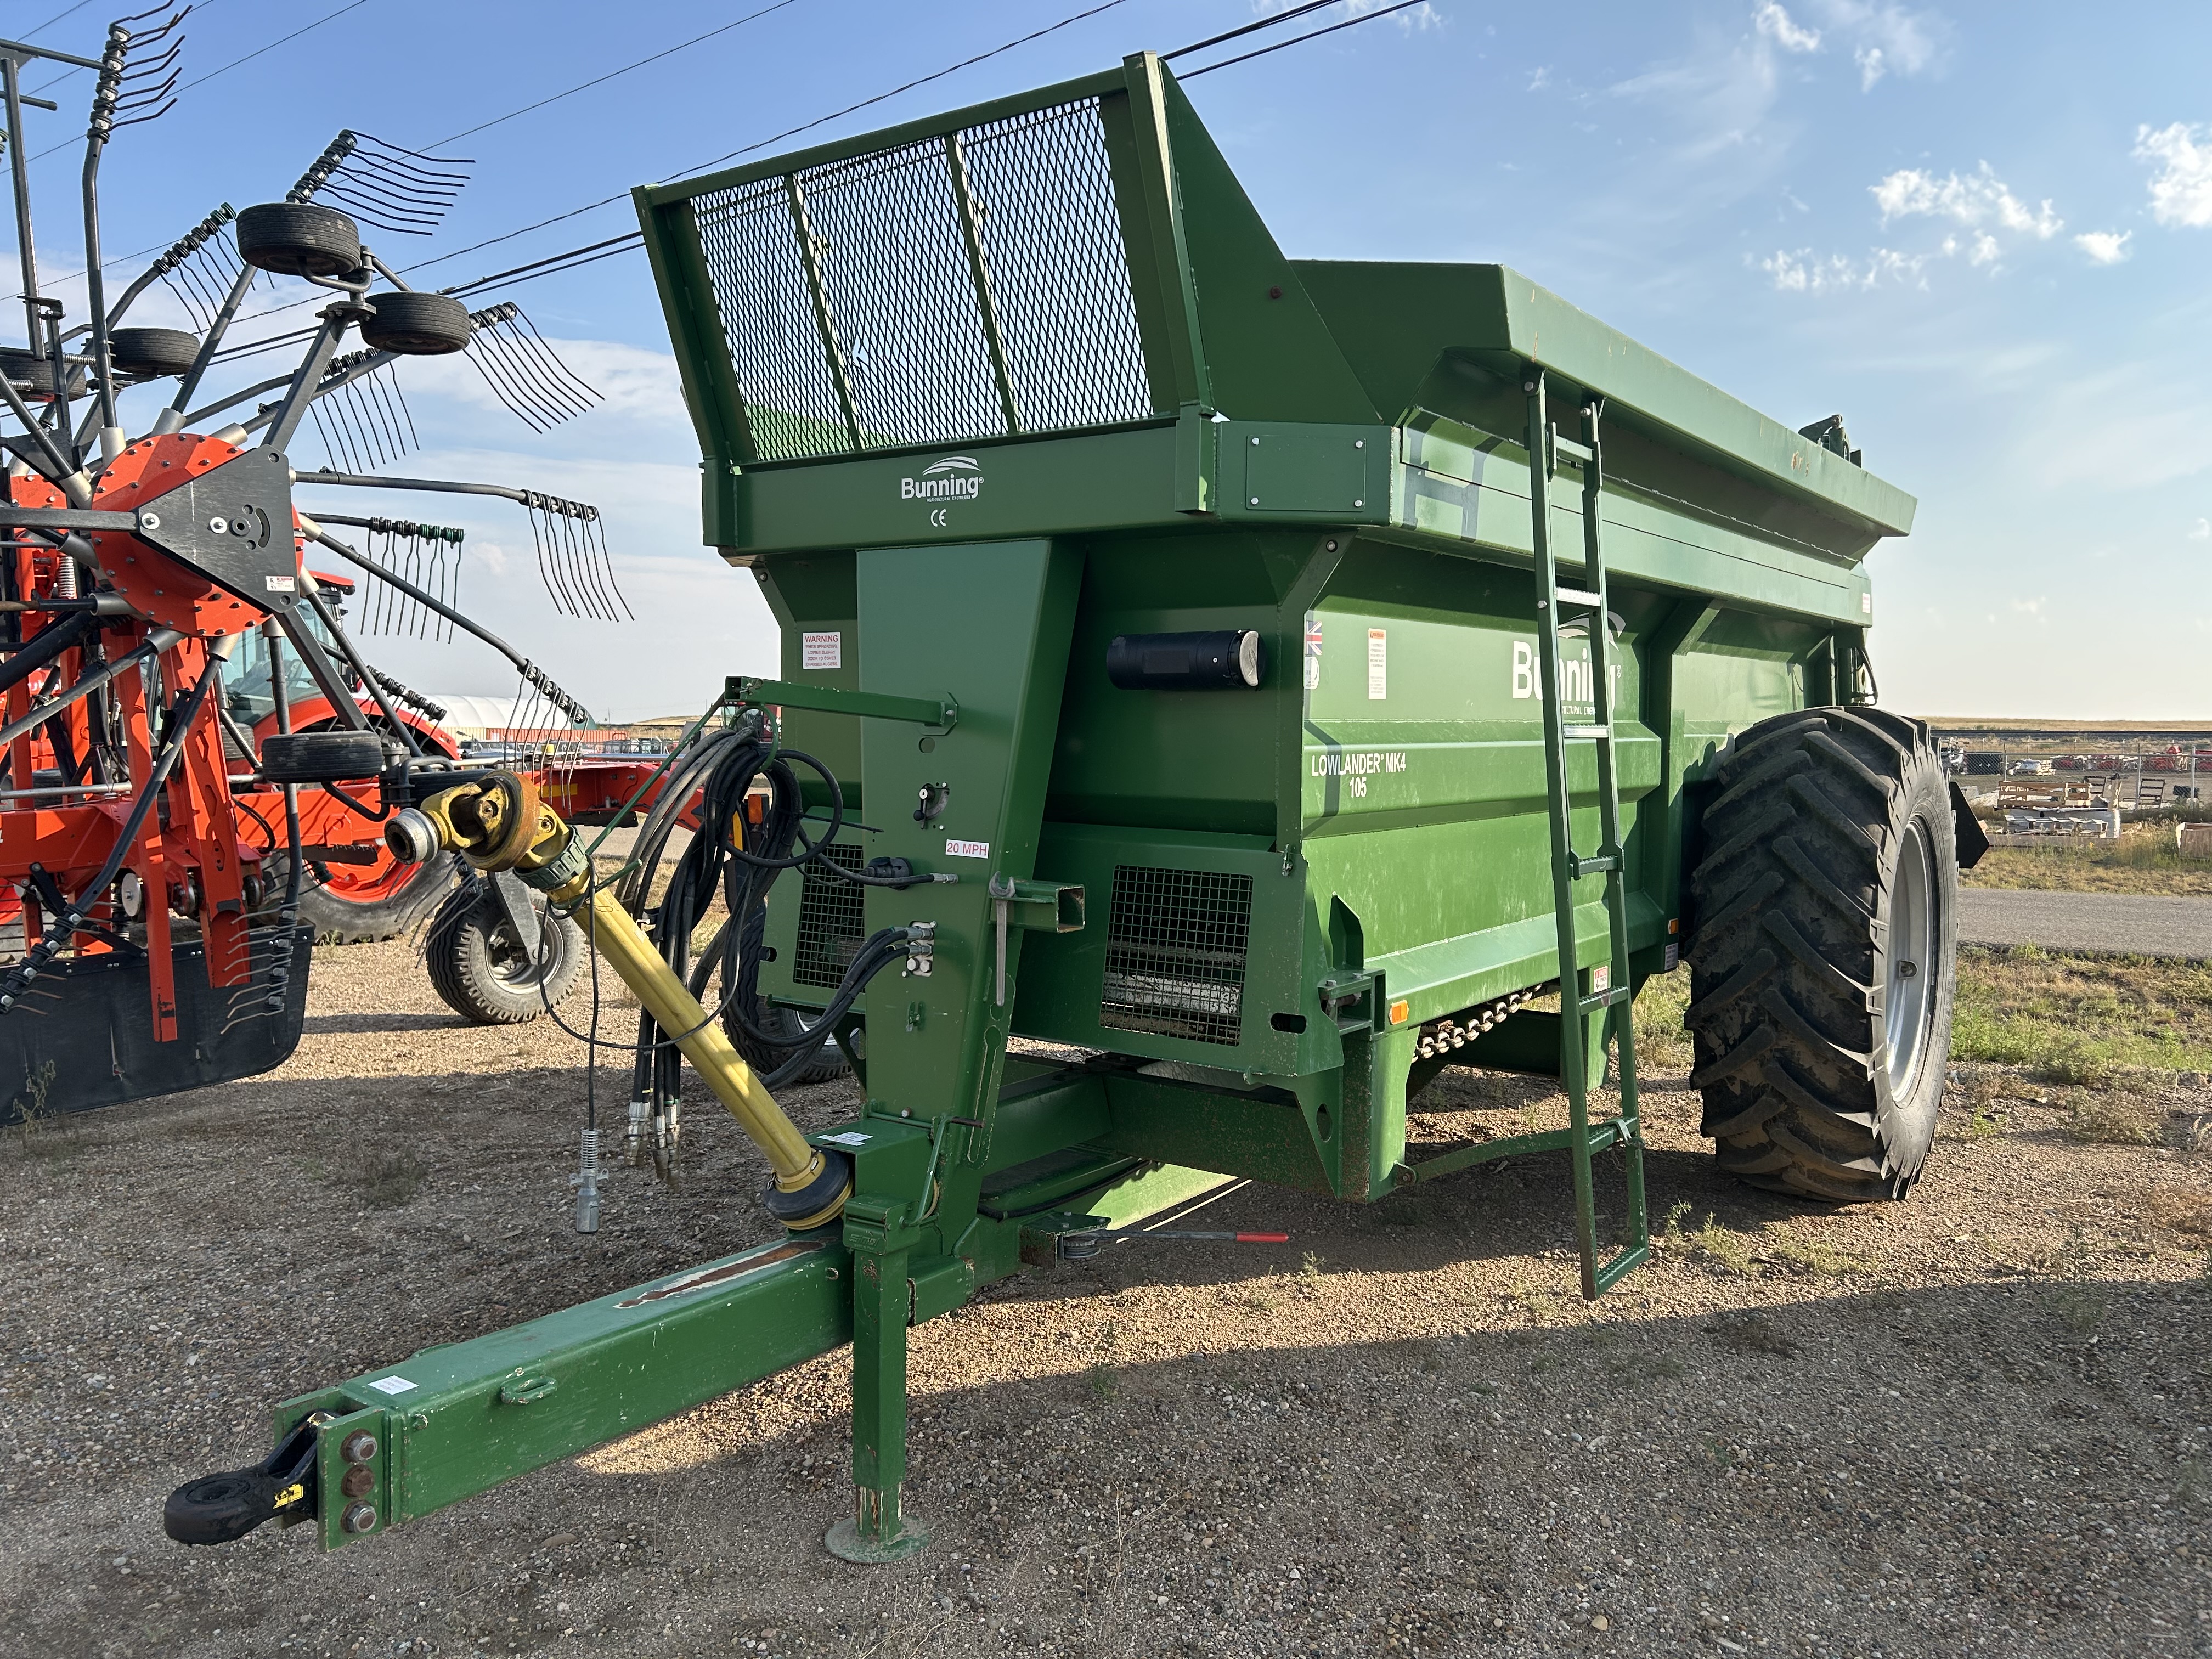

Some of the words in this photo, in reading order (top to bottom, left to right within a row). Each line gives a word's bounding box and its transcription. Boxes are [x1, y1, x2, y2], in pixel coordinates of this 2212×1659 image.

[1385, 752, 1406, 773] MK4
[1349, 777, 1367, 798] 105
[947, 842, 959, 853] 20
[962, 843, 987, 856] MPH
